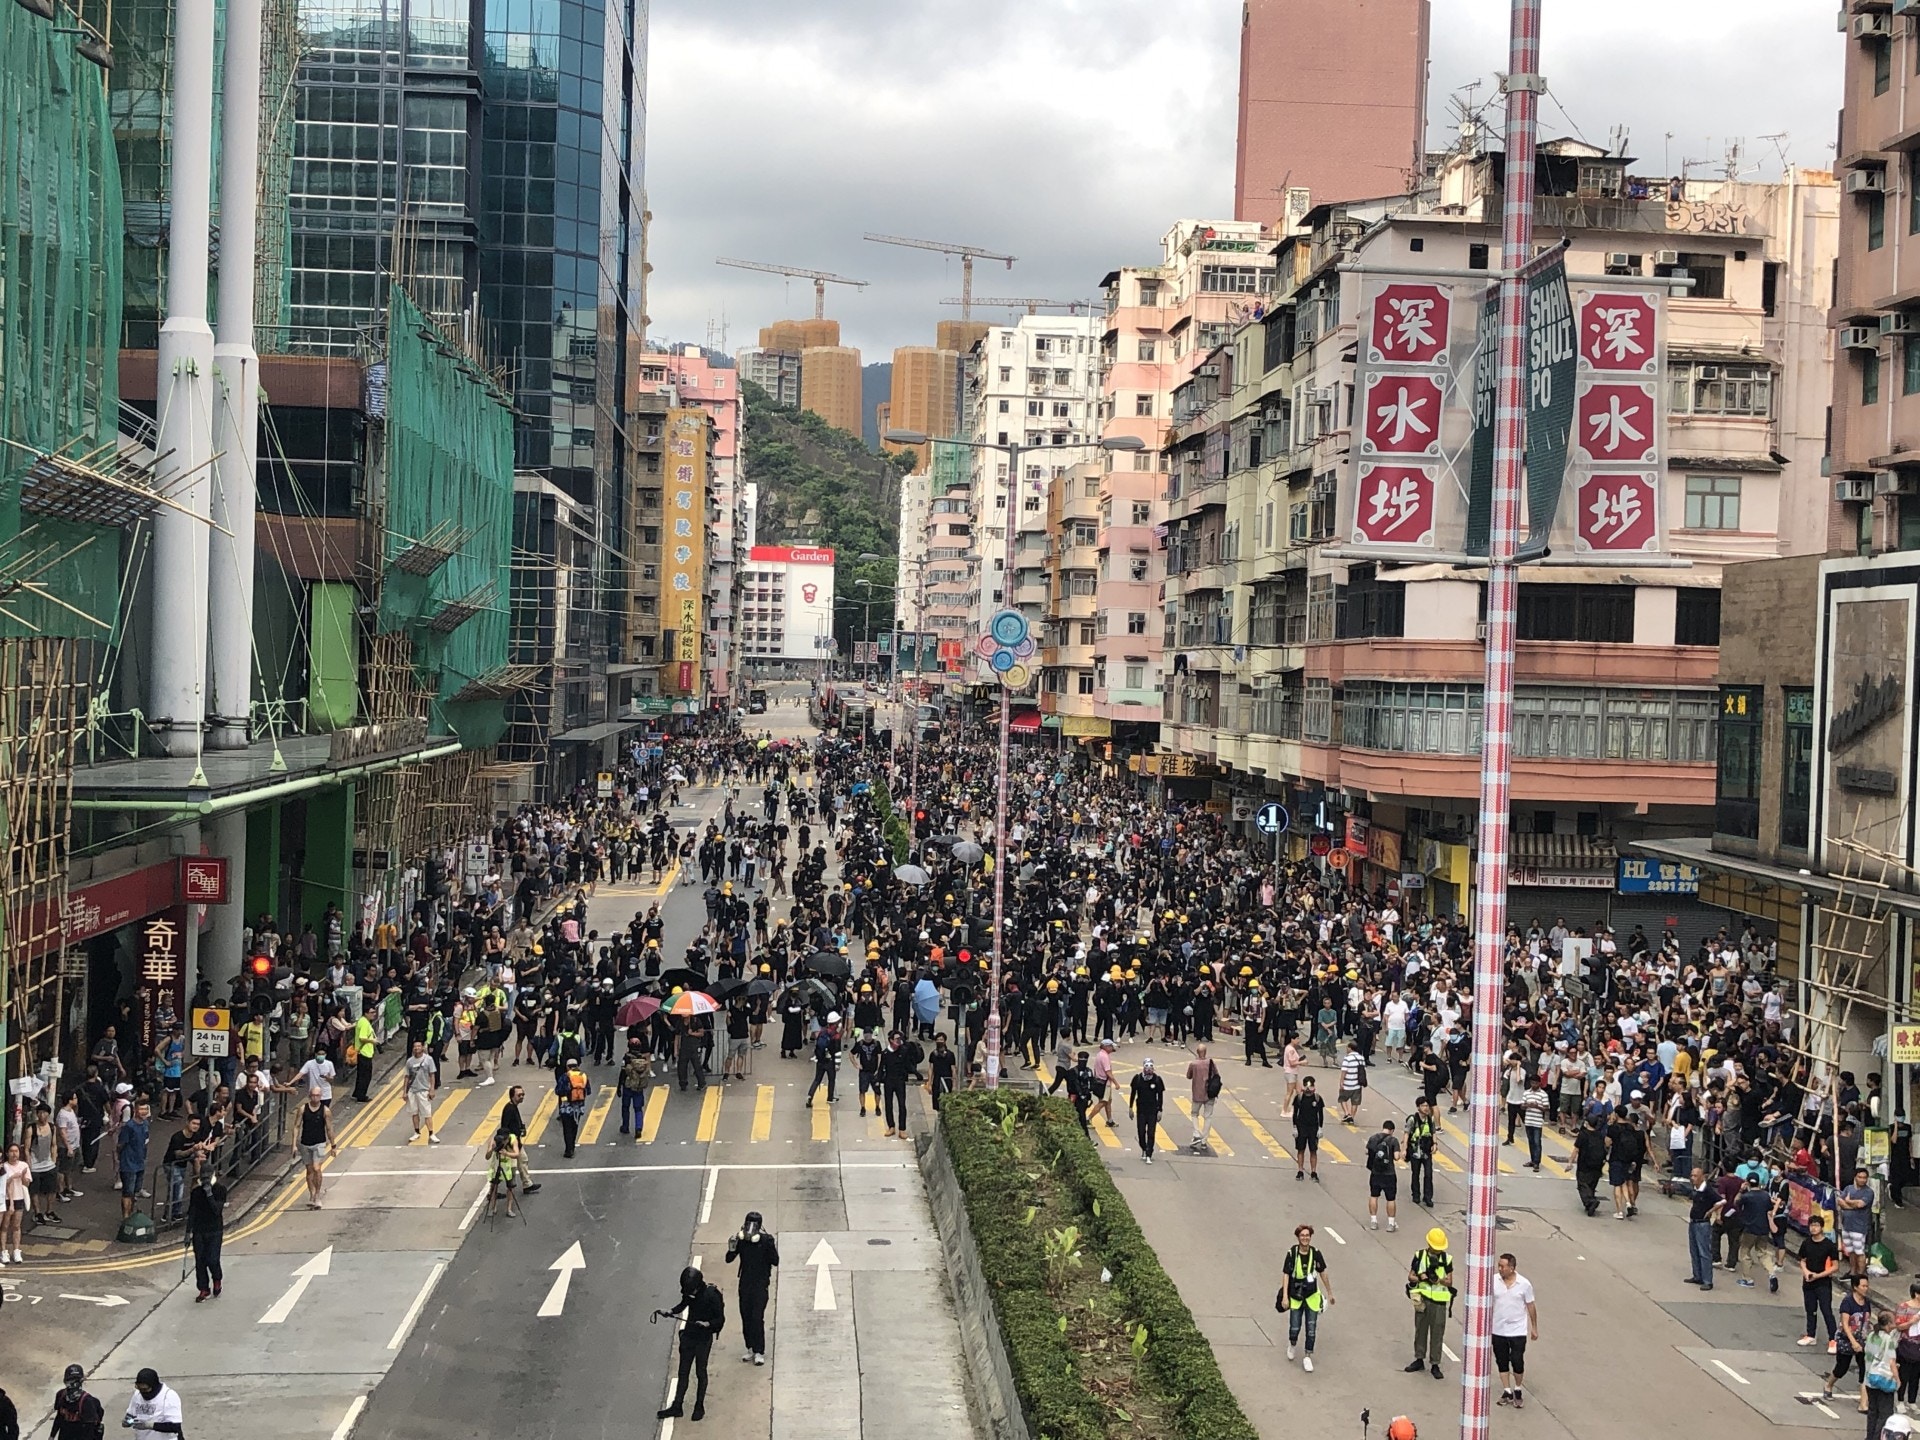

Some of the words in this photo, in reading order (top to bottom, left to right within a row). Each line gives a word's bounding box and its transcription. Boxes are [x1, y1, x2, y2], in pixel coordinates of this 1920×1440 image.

[1530, 275, 1570, 330] SHAM
[1479, 312, 1499, 355] SHA
[1530, 317, 1573, 371] SHUI
[1478, 350, 1498, 391] SHU
[1531, 368, 1552, 411] PO
[1368, 297, 1437, 536] 深水埗
[1475, 391, 1491, 430] PO
[1589, 307, 1646, 544] 深水埗
[790, 550, 829, 562] Garden
[1725, 694, 1746, 715] 火鍋
[188, 867, 219, 894] 奇華
[1623, 861, 1651, 879] HL
[144, 988, 153, 1003] kee
[143, 1003, 152, 1019] wah
[141, 1020, 152, 1047] bakery
[196, 1032, 209, 1041] 24
[210, 1032, 225, 1042] hrs
[198, 1043, 221, 1053] 全日
